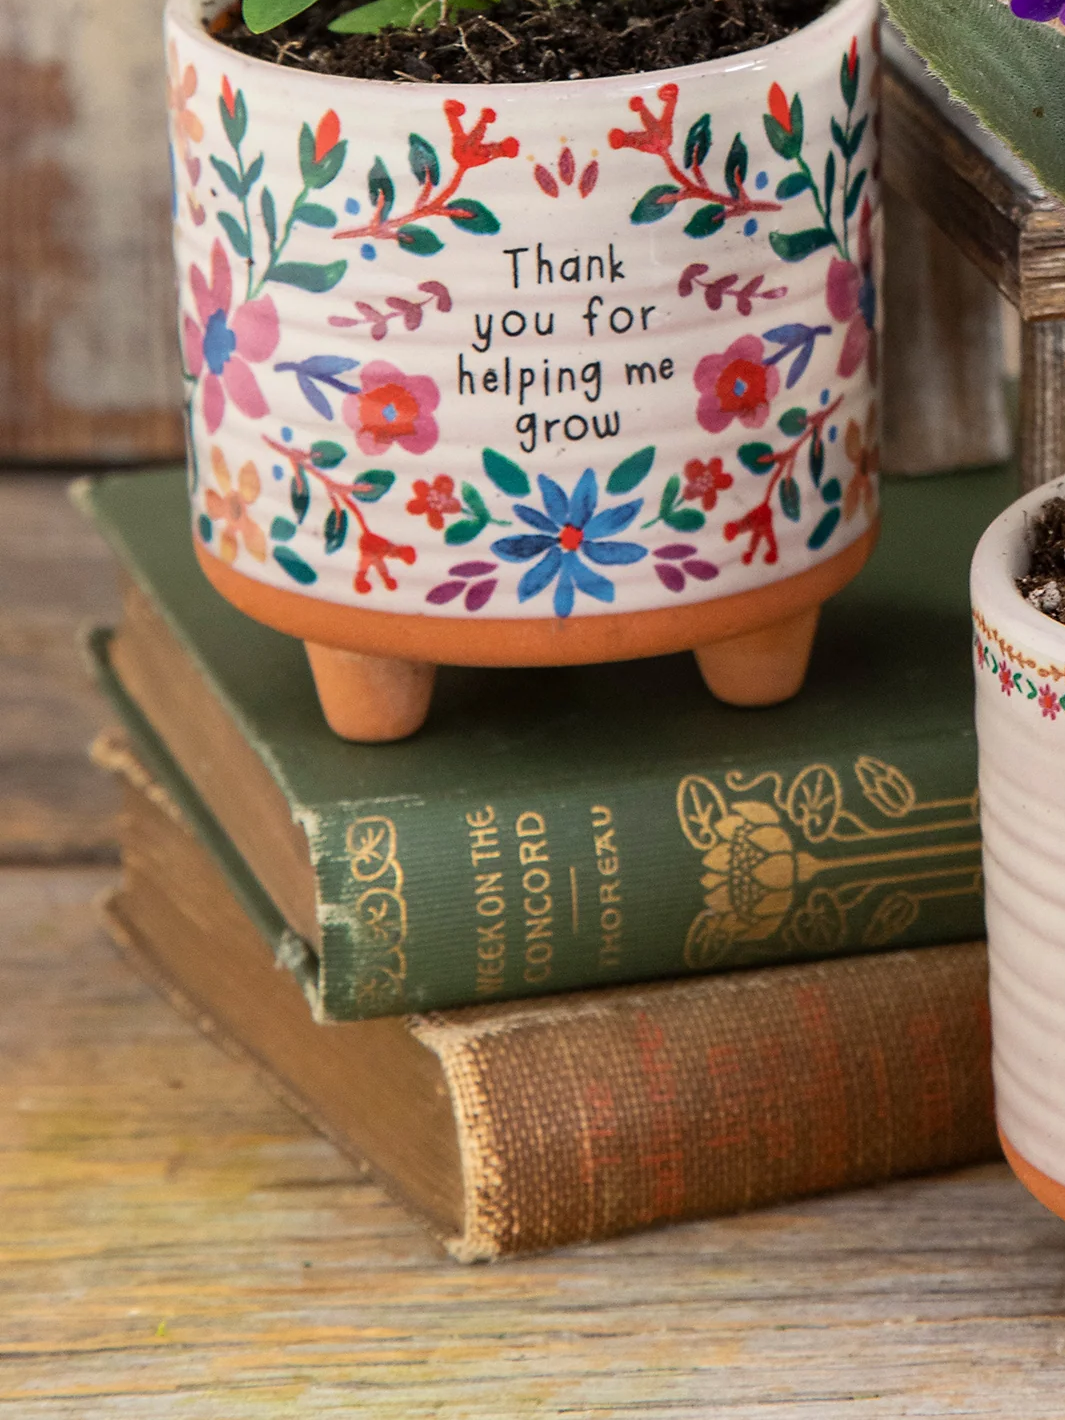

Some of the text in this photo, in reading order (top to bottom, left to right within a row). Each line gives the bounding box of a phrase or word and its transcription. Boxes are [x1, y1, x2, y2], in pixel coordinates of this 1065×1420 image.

[503, 242, 625, 289] Thank
[471, 295, 656, 353] you for
[458, 352, 675, 405] helping me
[516, 411, 620, 453] grow
[465, 804, 501, 867] THE
[474, 872, 506, 917] ON
[515, 811, 554, 984] CONCORD
